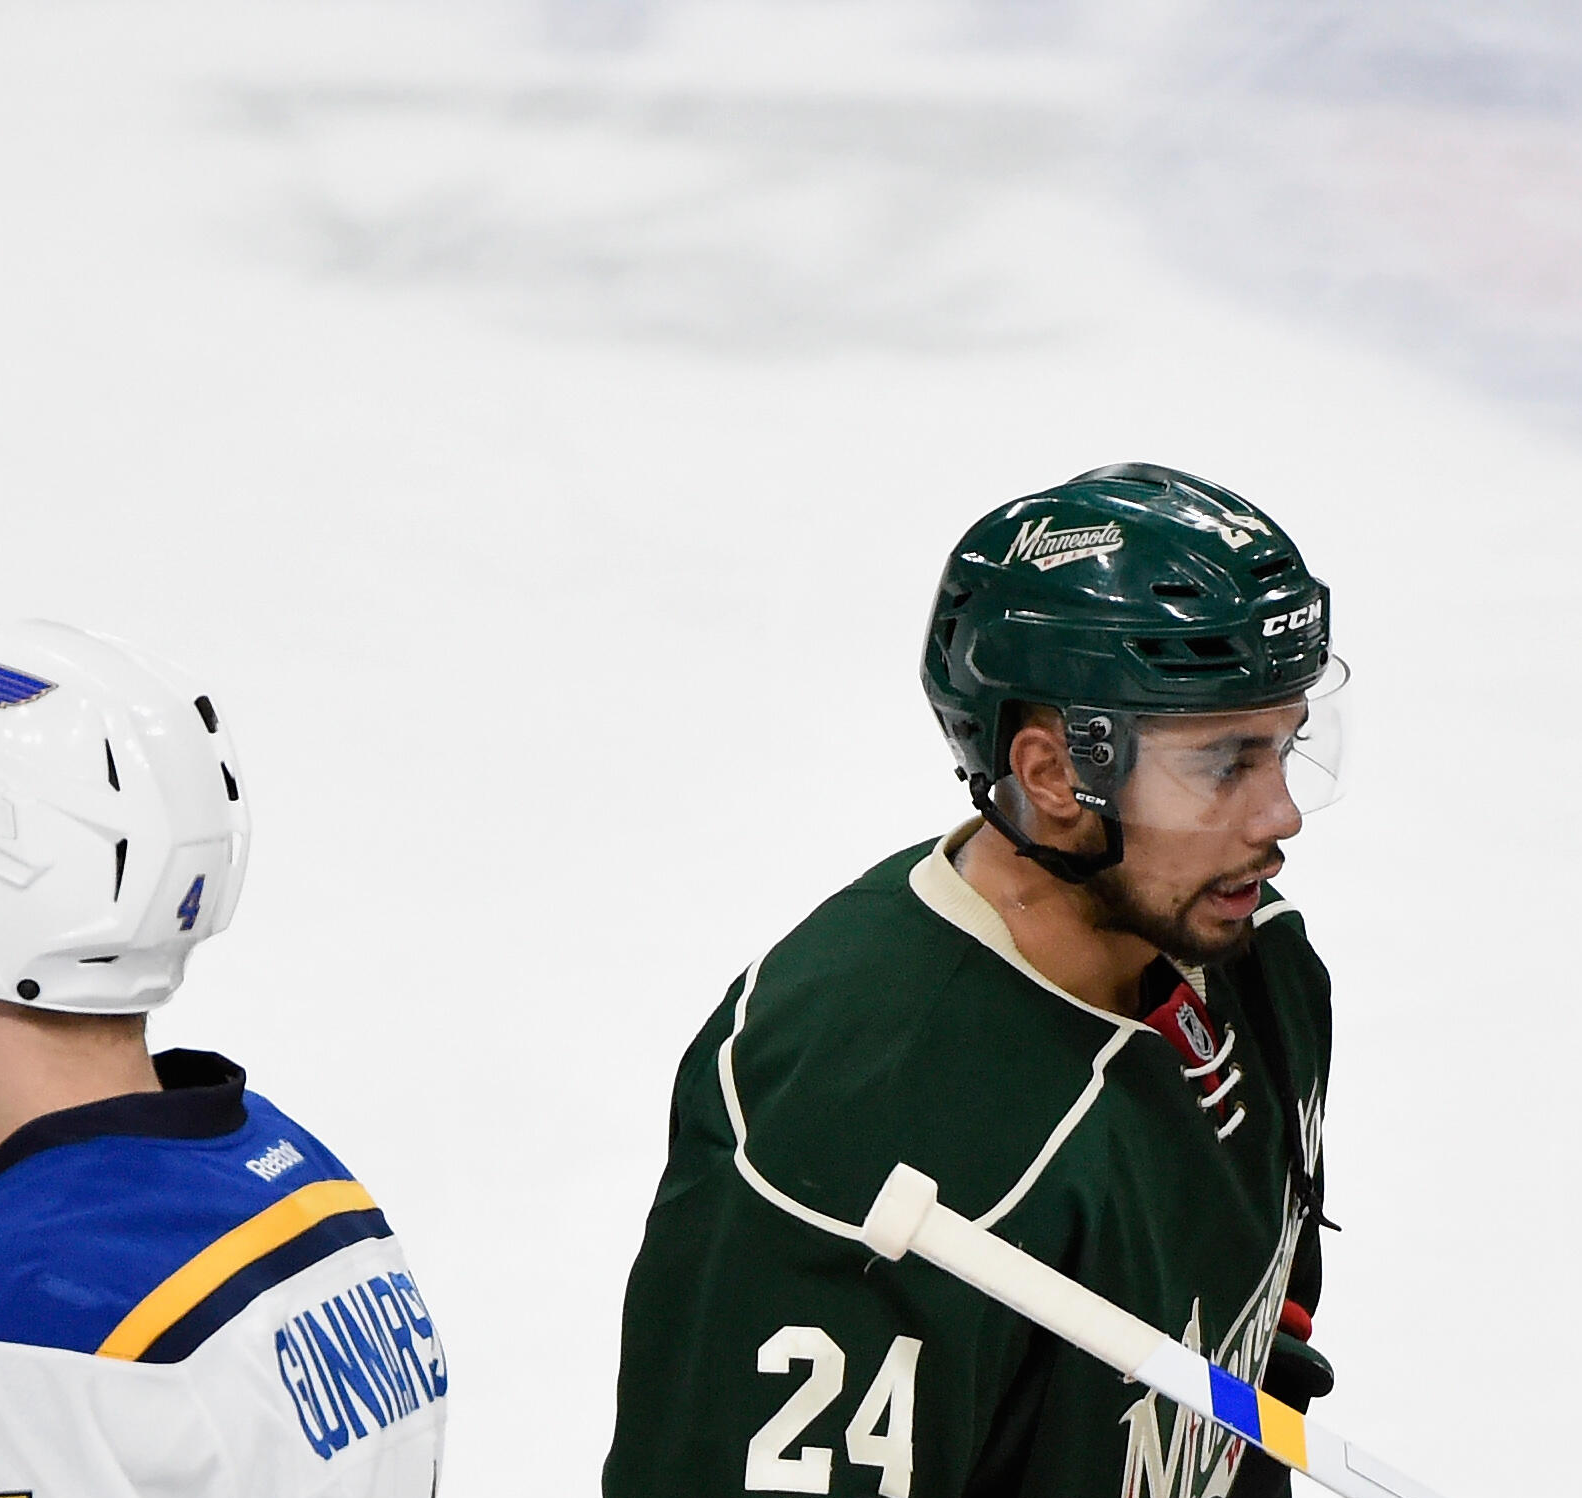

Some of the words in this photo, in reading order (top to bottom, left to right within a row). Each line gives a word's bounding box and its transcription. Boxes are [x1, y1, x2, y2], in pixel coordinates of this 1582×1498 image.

[1000, 516, 1122, 566] Minnesota
[1262, 599, 1322, 637] CCM
[1075, 792, 1107, 806] CCM
[177, 873, 206, 931] 4
